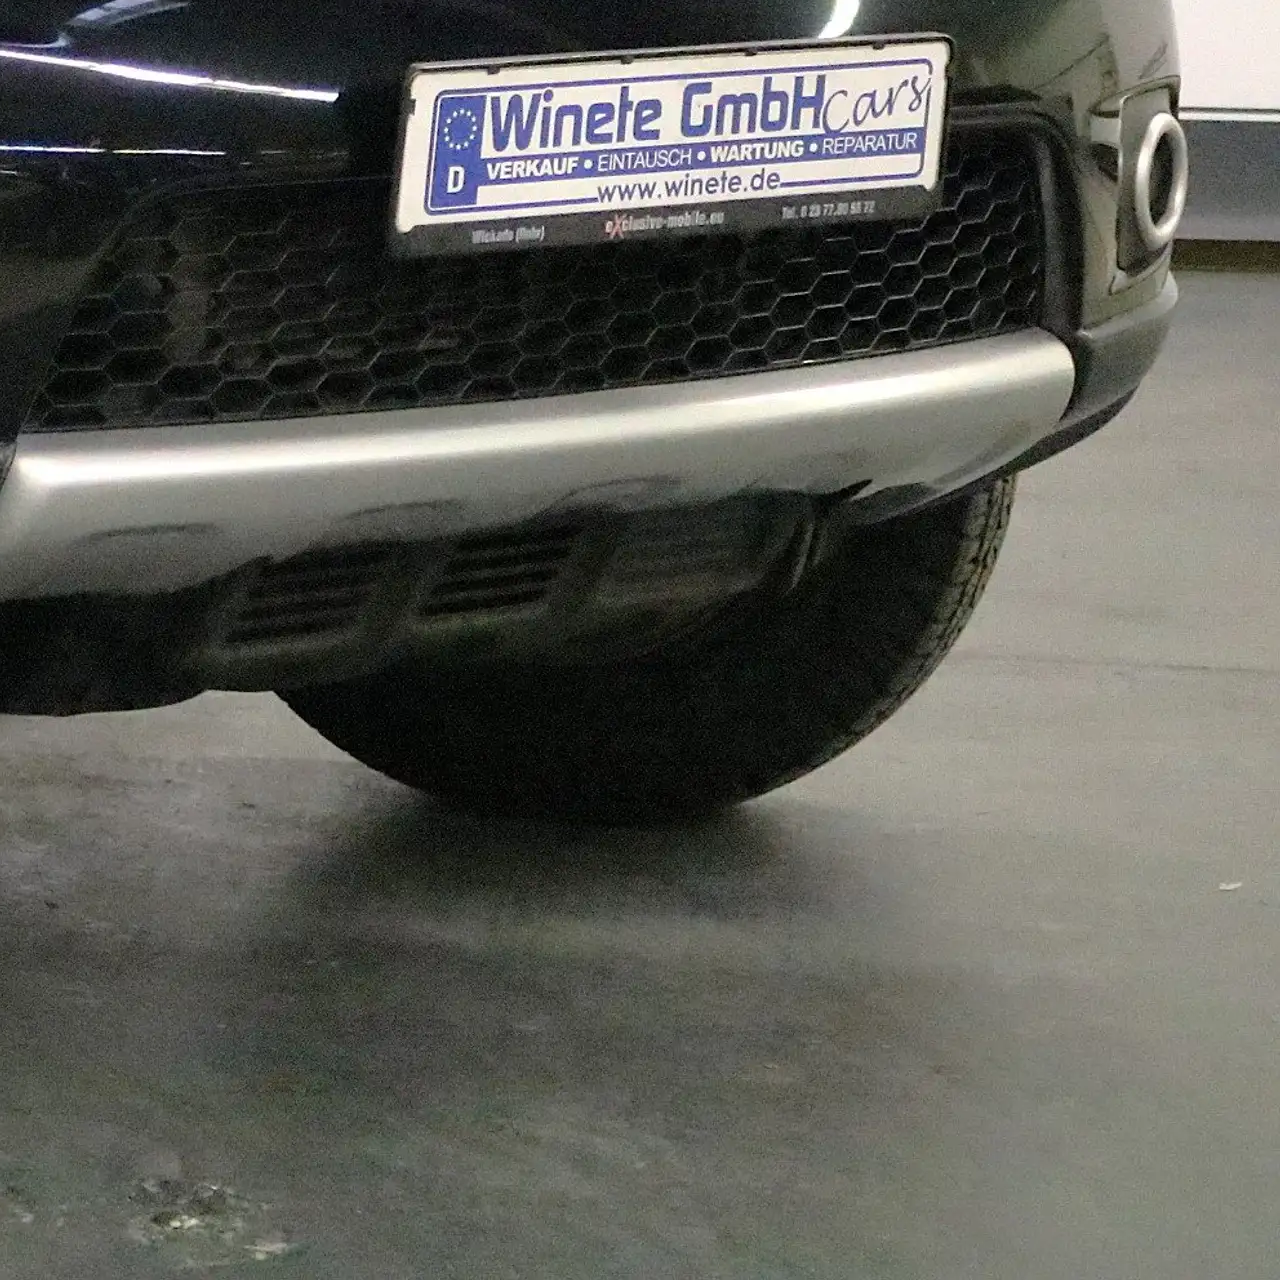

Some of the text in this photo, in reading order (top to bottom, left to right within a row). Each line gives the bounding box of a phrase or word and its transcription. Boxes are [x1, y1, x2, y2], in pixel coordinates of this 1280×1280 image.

[490, 86, 662, 152] Winete
[680, 74, 826, 137] GmbH
[487, 132, 918, 181] VERKAUF EINTAUSCH WARTUNG REPARATUR
[446, 166, 465, 194] D
[597, 167, 781, 206] www.winete.de
